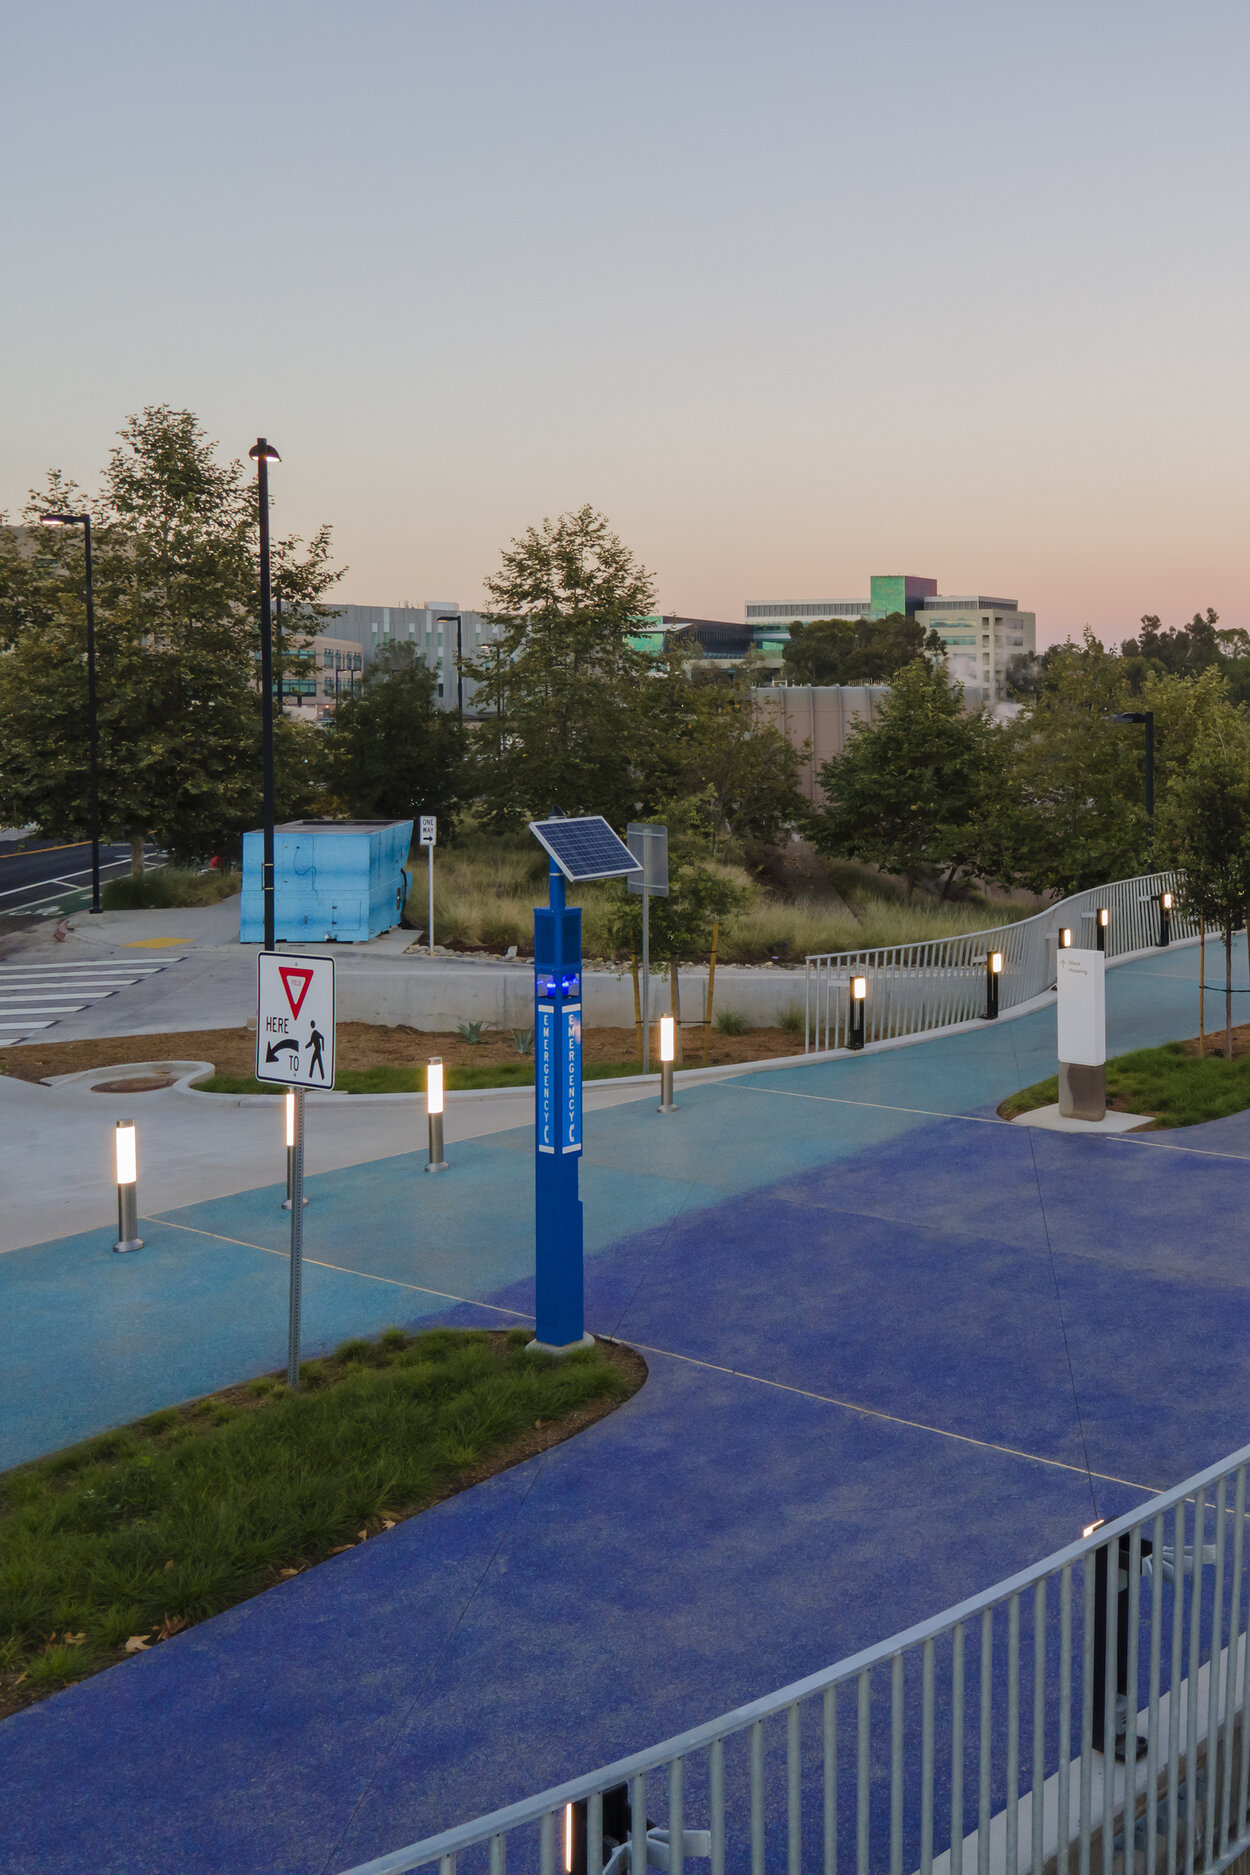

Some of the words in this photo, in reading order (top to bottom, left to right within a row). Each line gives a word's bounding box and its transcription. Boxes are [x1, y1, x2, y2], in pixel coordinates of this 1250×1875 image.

[266, 1016, 289, 1034] HERE
[289, 1055, 300, 1072] TO
[568, 1014, 576, 1122] EMERGENCY
